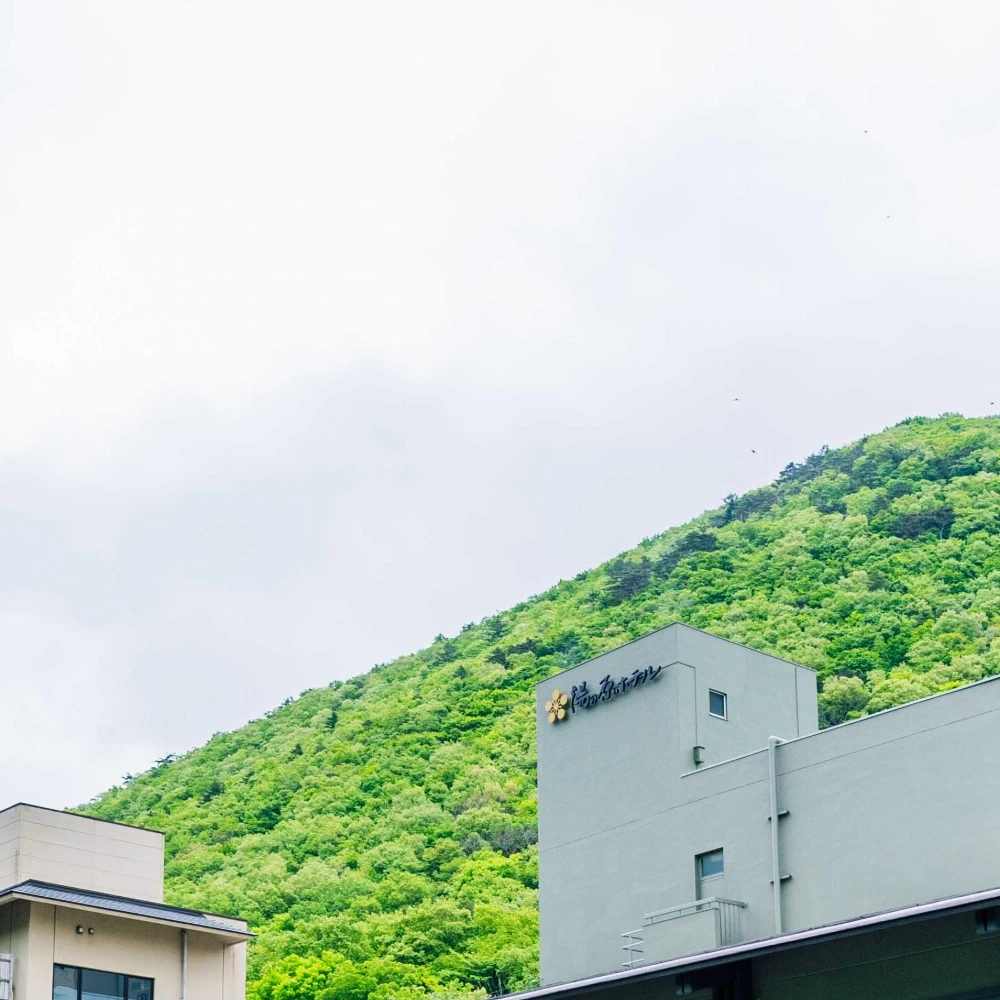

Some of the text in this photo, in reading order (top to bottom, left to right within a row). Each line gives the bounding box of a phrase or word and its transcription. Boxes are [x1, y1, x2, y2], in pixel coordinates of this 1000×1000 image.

[571, 665, 662, 713] 湯の原ホテル
